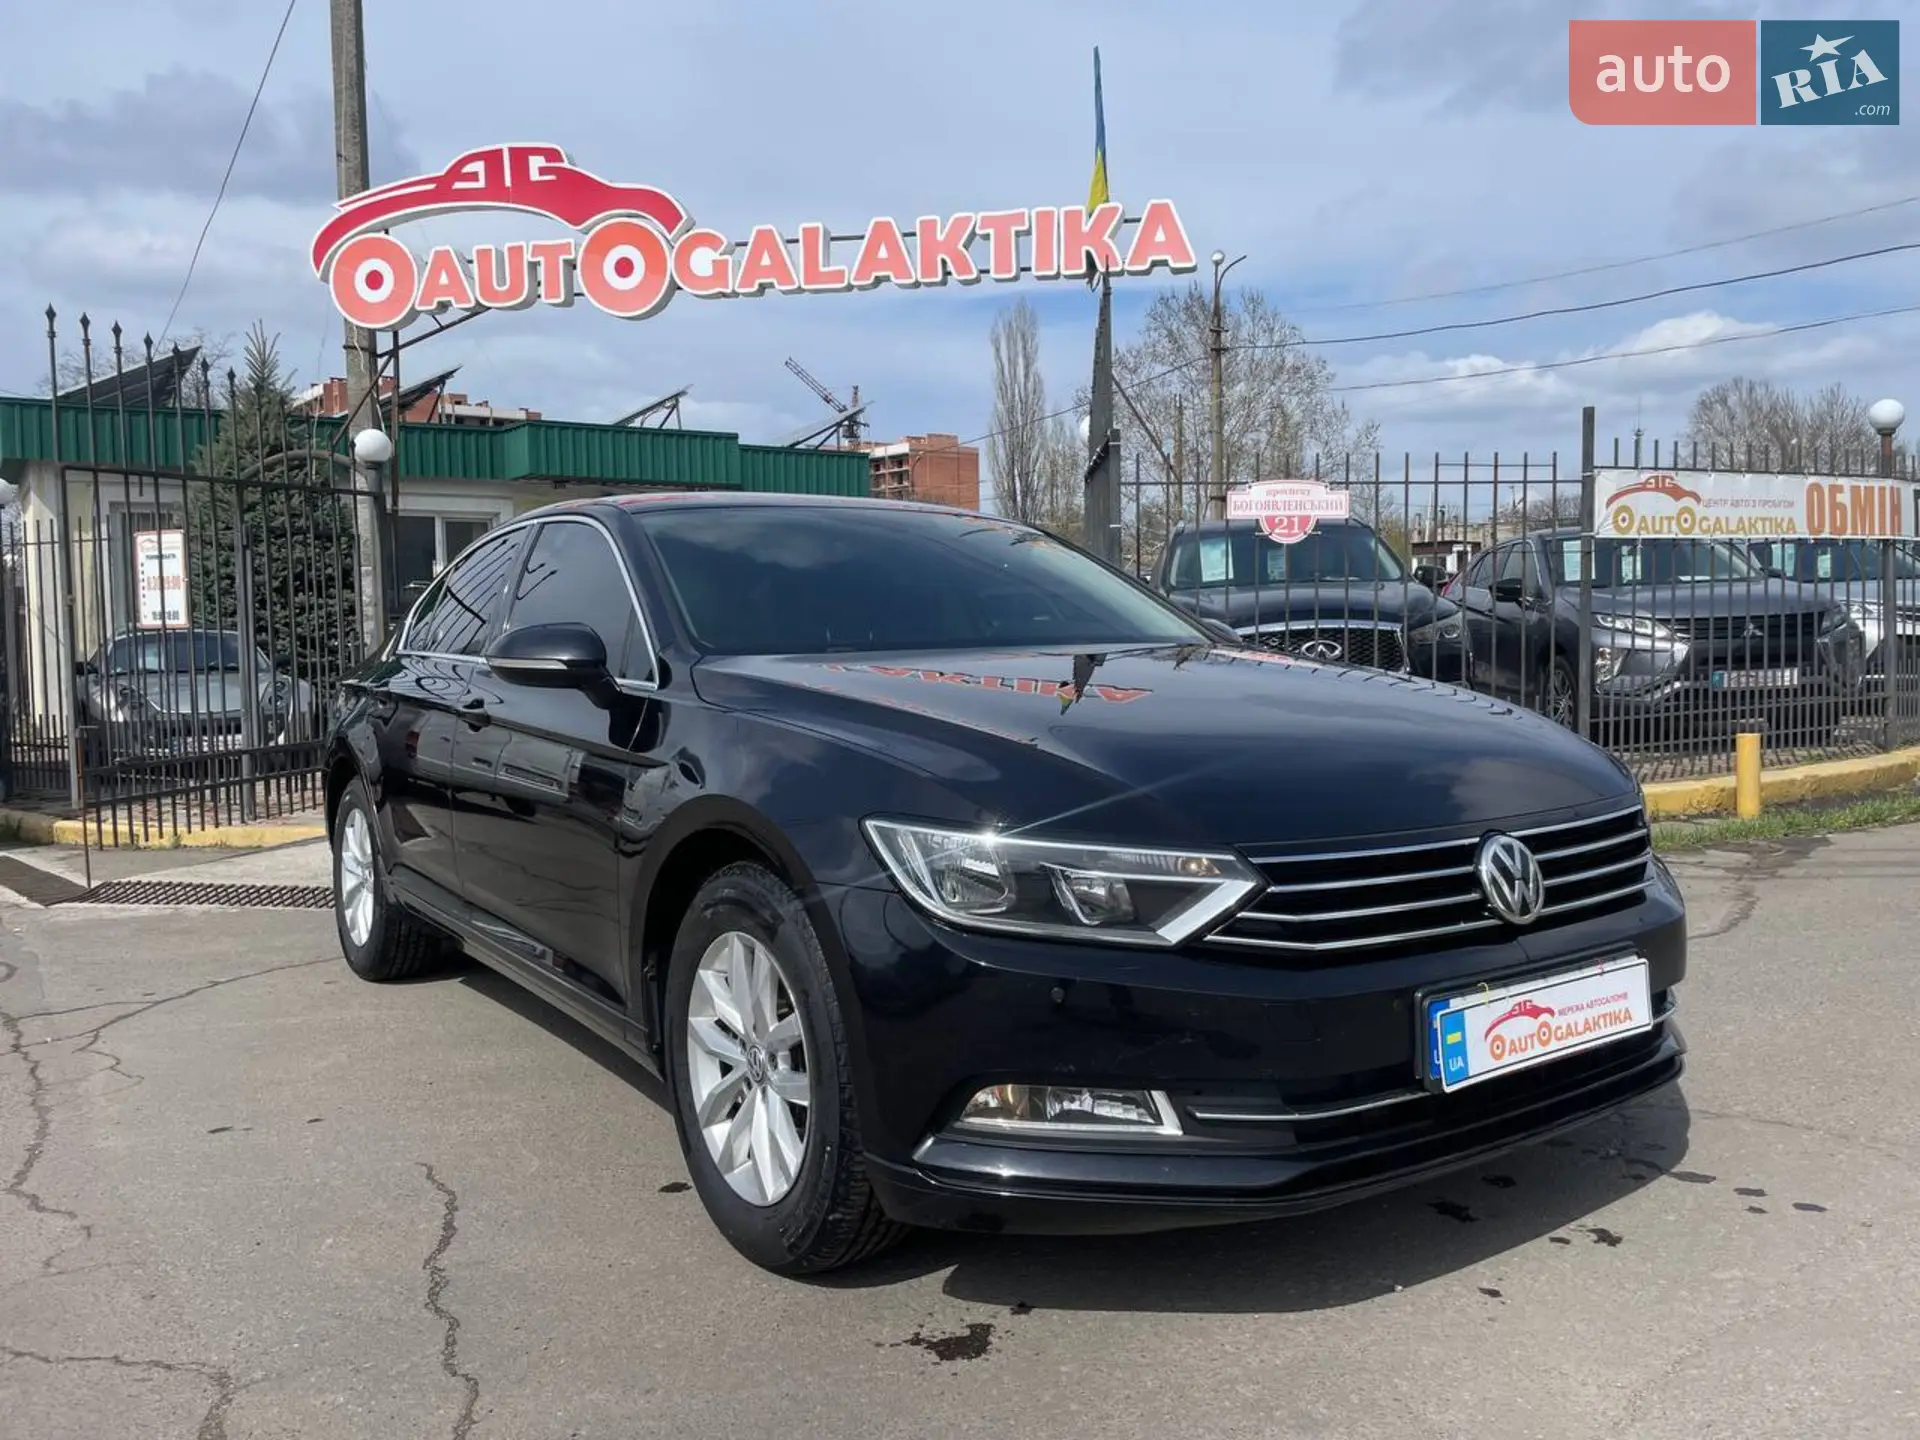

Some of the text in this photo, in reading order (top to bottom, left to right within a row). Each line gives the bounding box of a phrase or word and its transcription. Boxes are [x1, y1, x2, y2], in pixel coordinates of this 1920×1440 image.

[1806, 481, 1902, 536] ОБМІН
[1275, 516, 1301, 533] 21
[1448, 1055, 1465, 1072] UA
